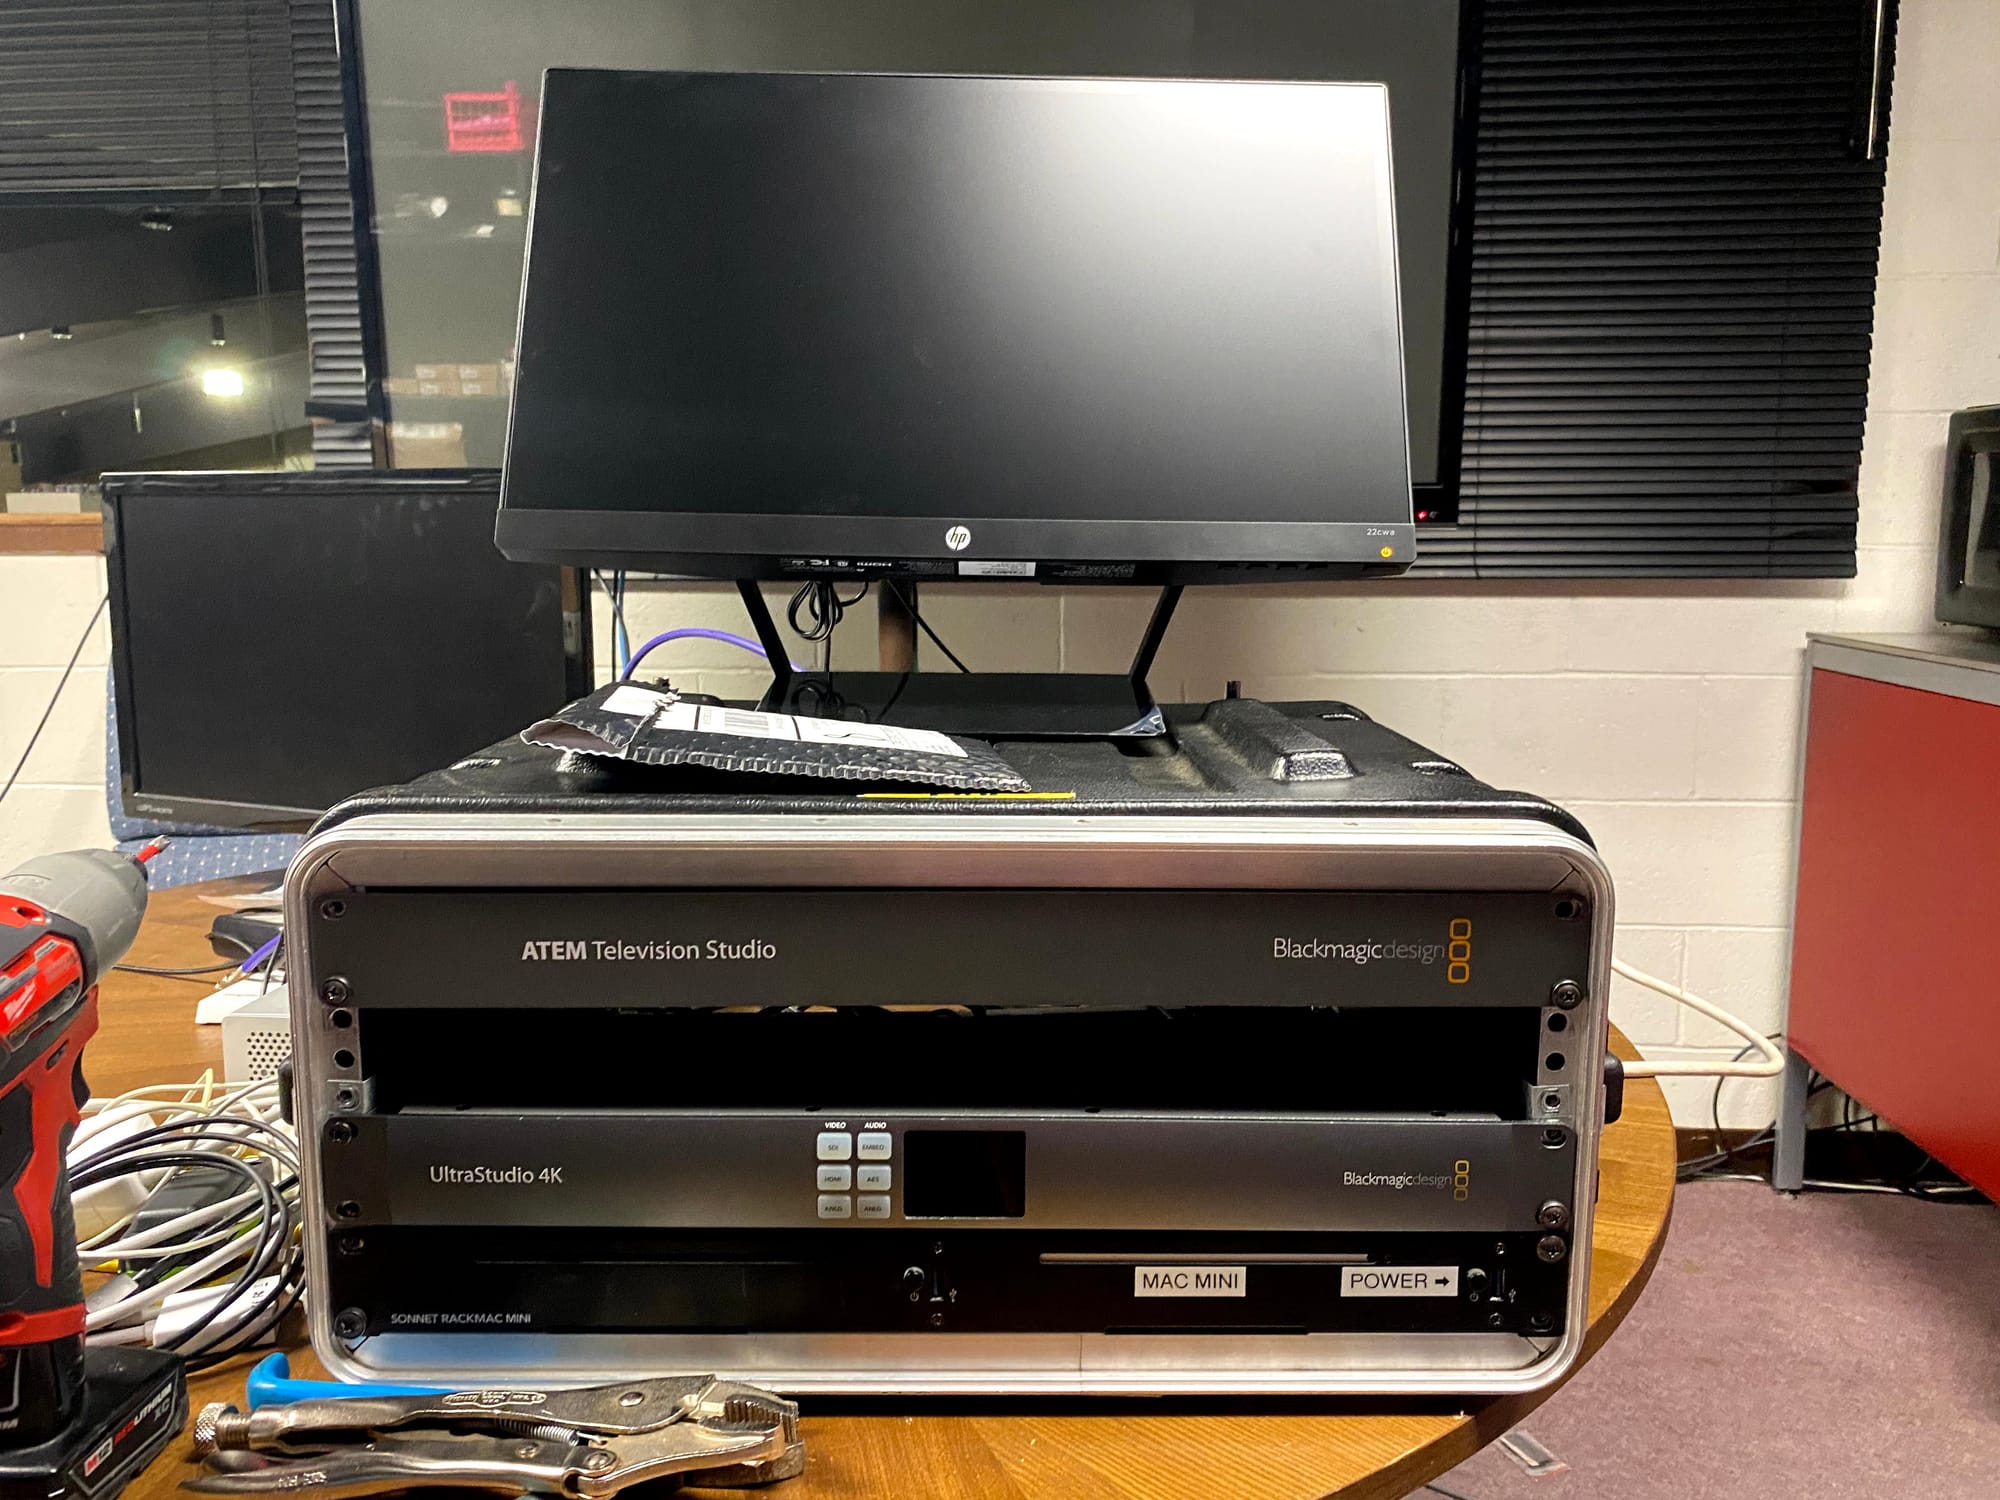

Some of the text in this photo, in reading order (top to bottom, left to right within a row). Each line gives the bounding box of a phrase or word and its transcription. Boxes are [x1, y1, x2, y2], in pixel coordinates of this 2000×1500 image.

[949, 526, 968, 551] hp
[1366, 528, 1395, 536] 22cwa
[521, 939, 777, 960] ATEM Television Studio
[1273, 937, 1446, 965] Blackmagicdesign
[825, 1121, 846, 1129] VIDEO
[864, 1121, 887, 1129] AUDIO
[430, 1165, 563, 1184] UltraStudio 4K
[1343, 1171, 1453, 1189] Blackmagicdesign
[1142, 1273, 1239, 1289] MAC MINI
[1350, 1273, 1428, 1289] POWER
[391, 1313, 531, 1324] SONNET RACKMAC MINI
